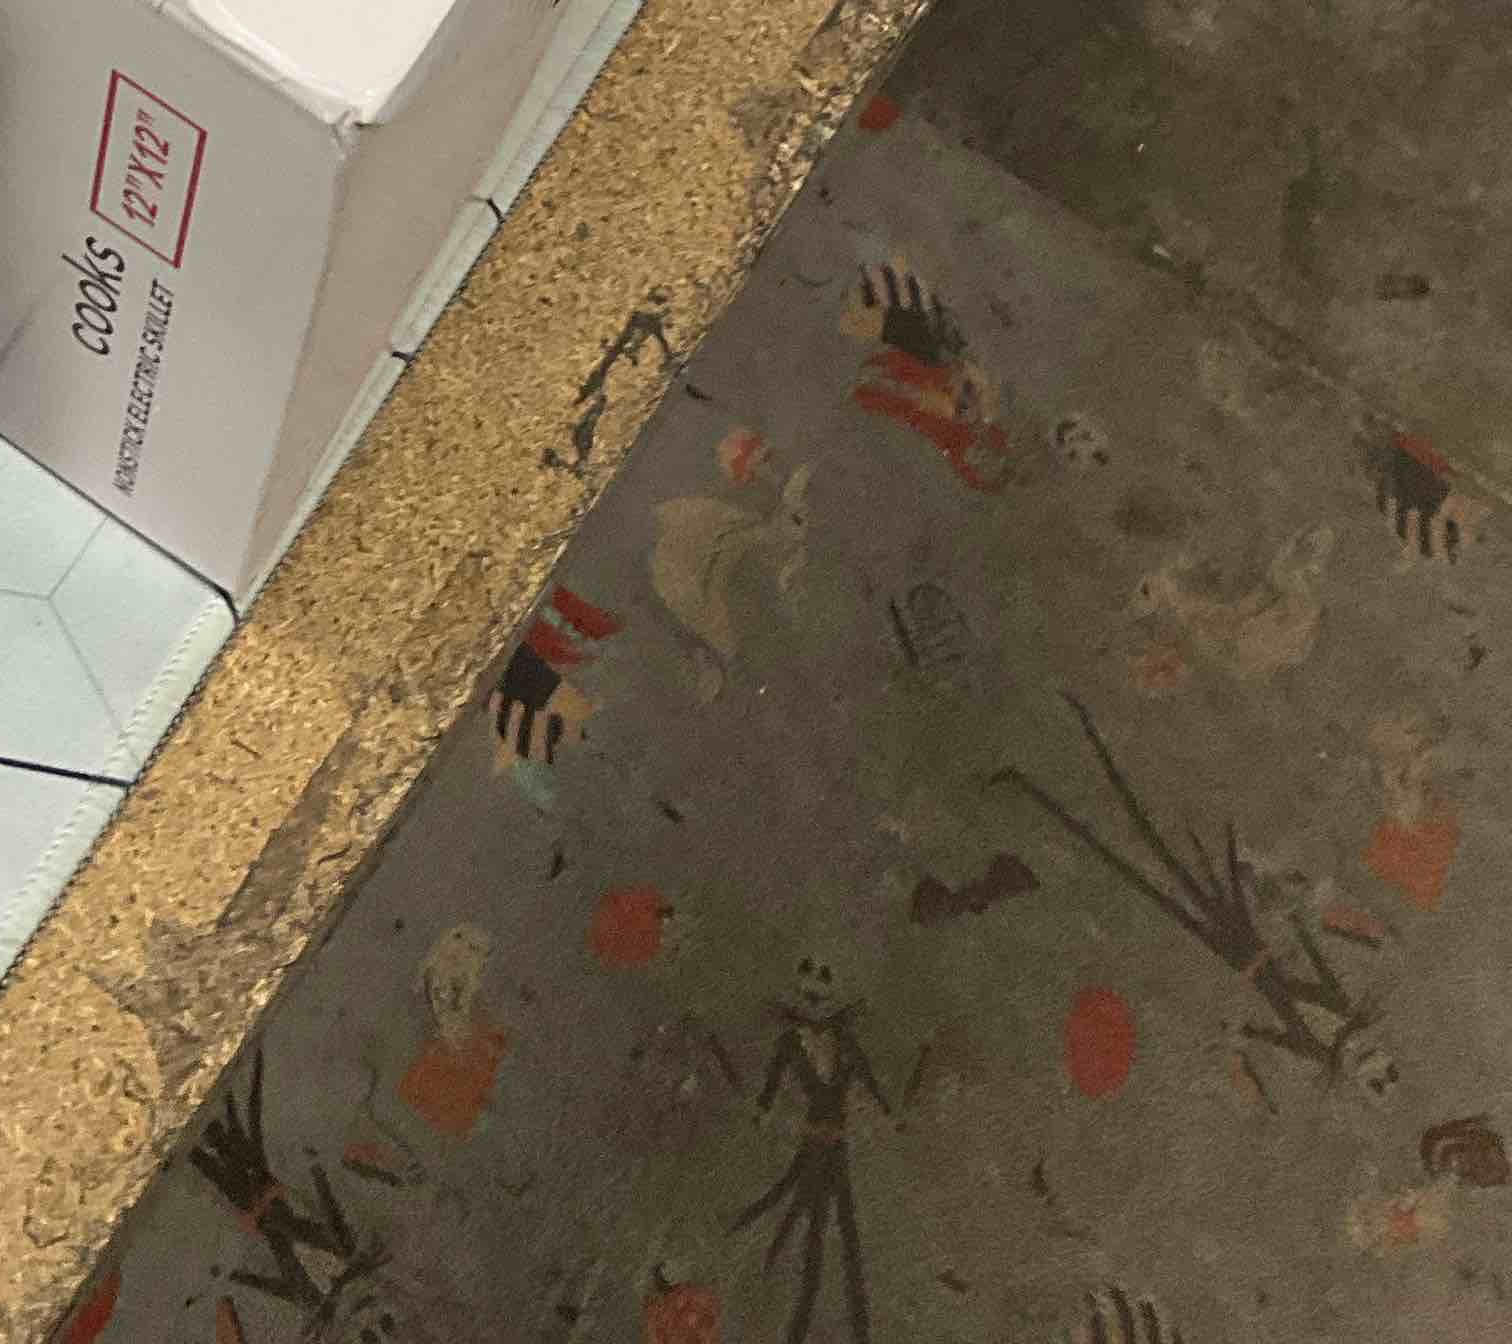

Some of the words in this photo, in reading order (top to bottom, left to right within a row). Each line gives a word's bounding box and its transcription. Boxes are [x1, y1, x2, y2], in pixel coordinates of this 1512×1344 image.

[62, 236, 125, 355] cooks
[142, 277, 174, 351] SKILLET
[128, 346, 161, 424] ELECTRIC
[112, 417, 146, 496] NONSTICK
